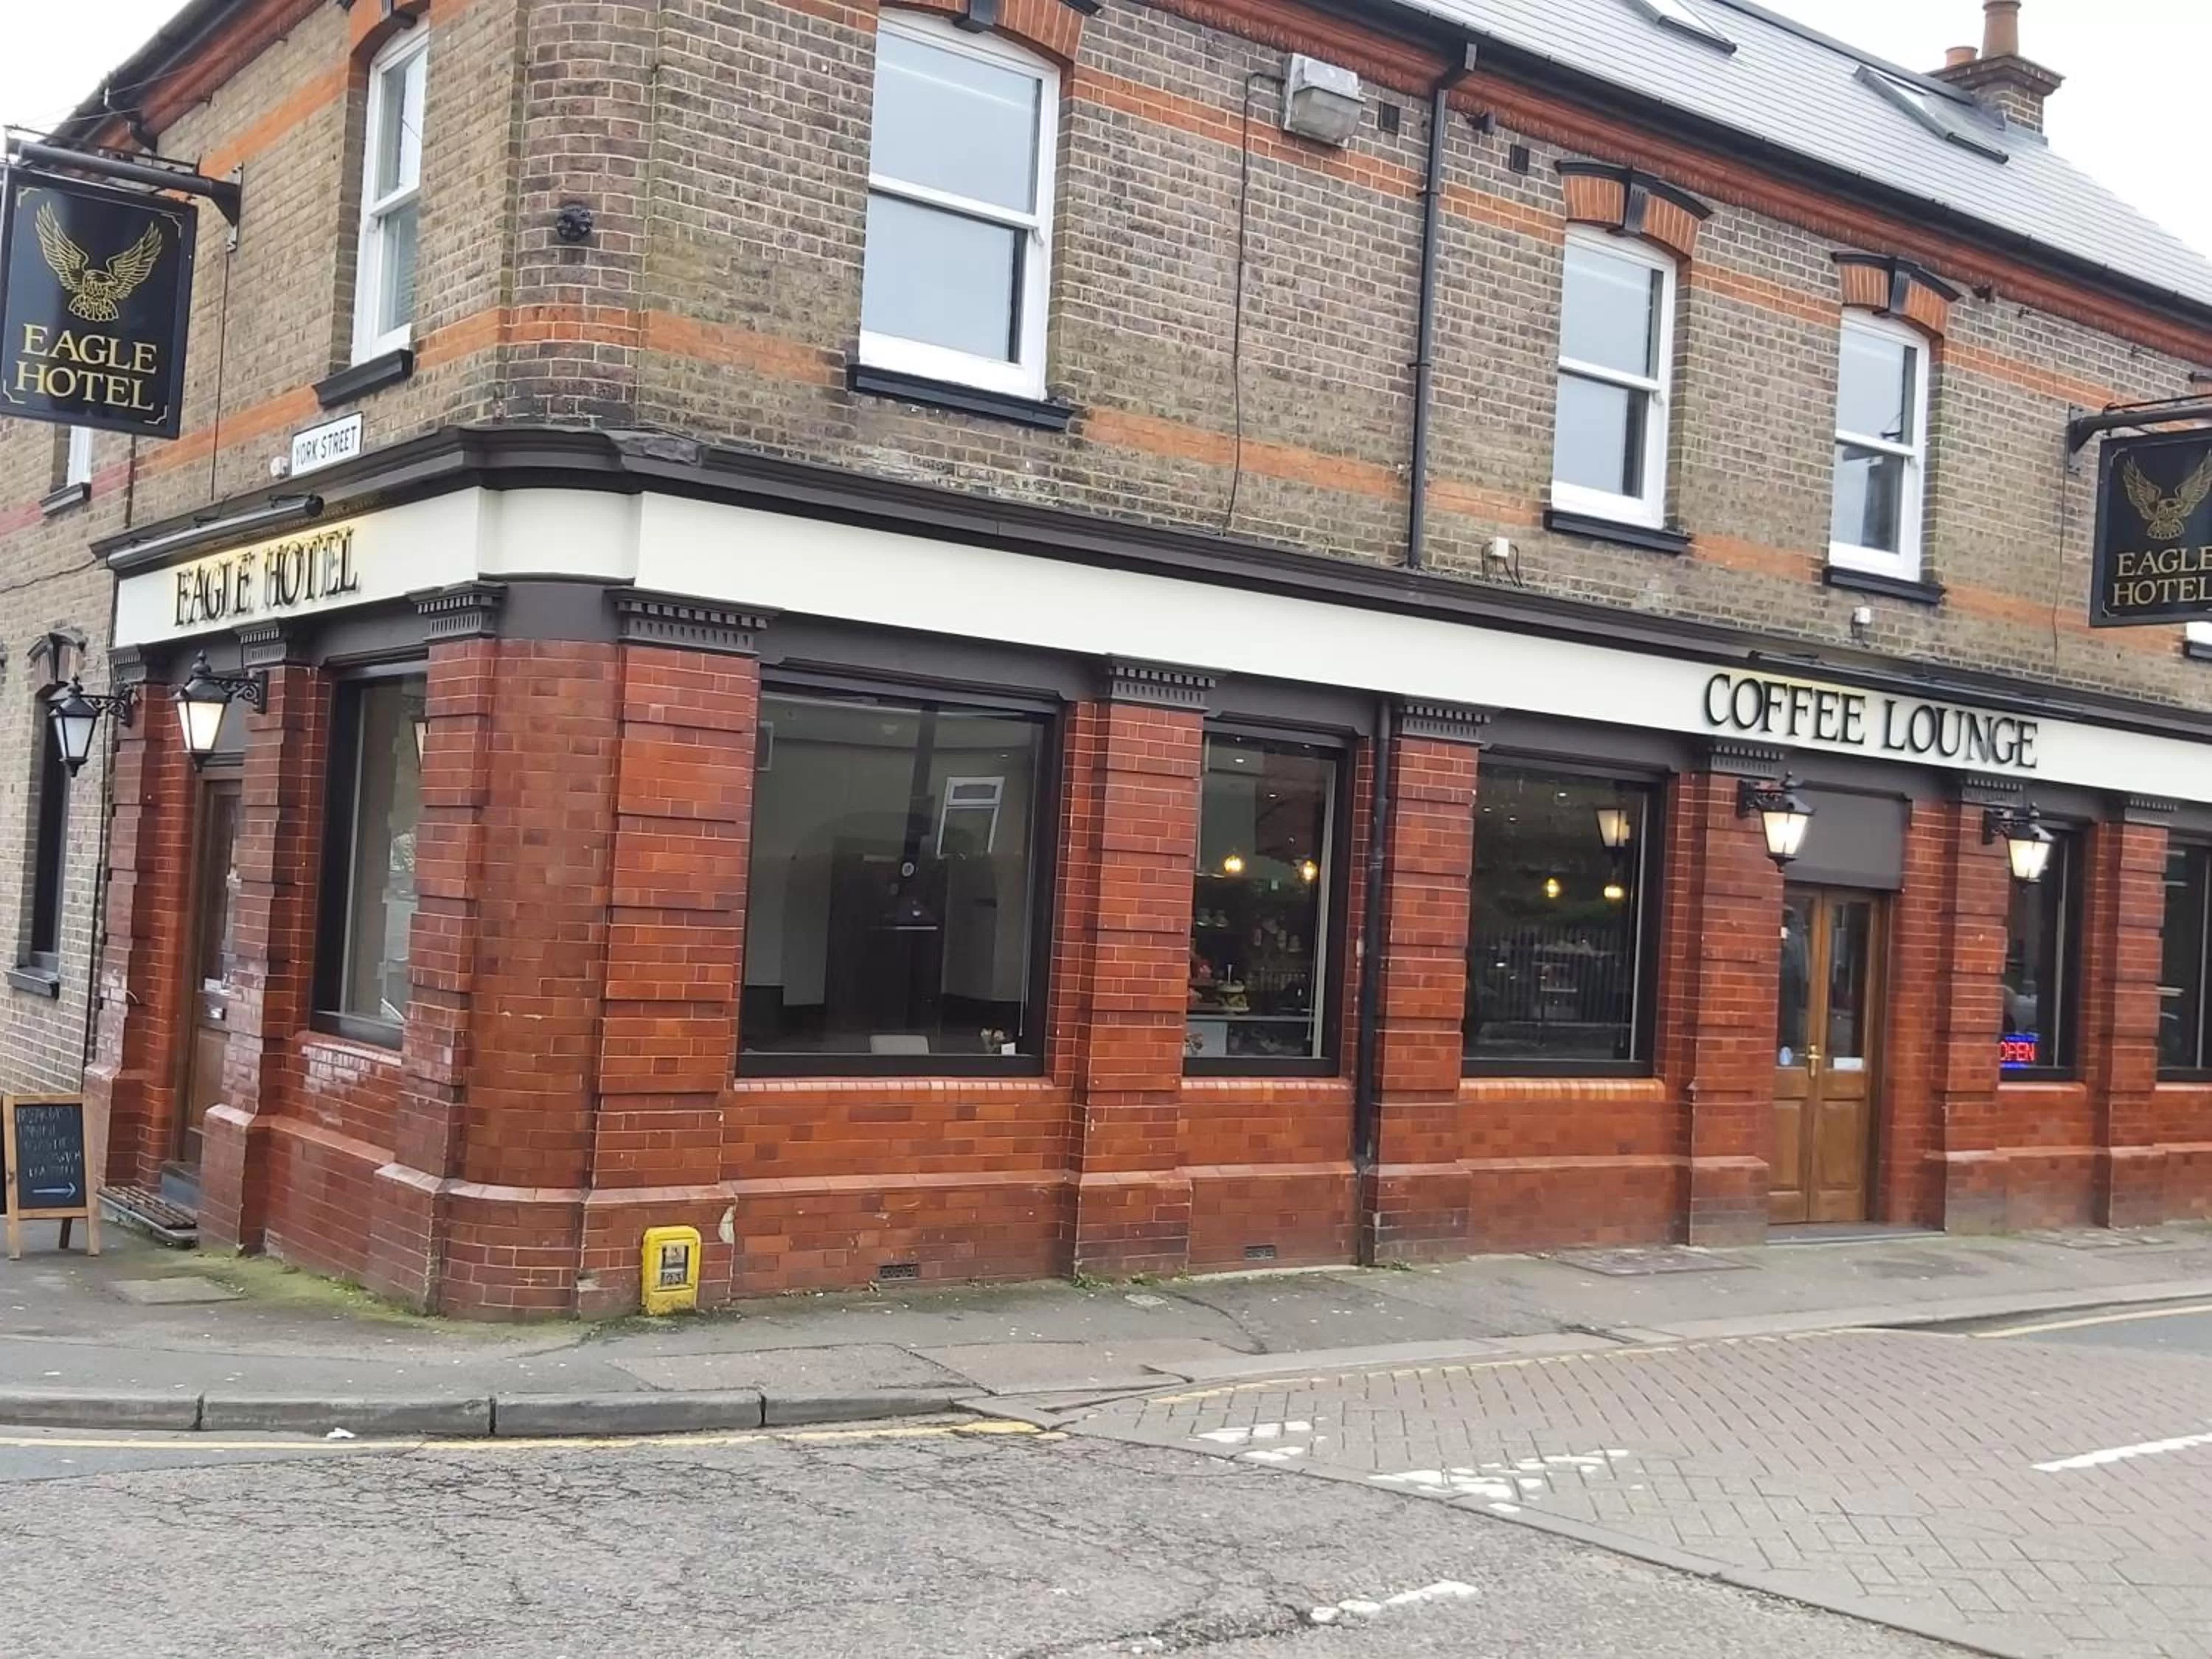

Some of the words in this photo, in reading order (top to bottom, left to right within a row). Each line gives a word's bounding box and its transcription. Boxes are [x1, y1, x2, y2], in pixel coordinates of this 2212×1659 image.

[23, 324, 157, 375] EAGLE
[15, 361, 154, 411] HOTEL
[296, 438, 319, 467] YORK
[321, 425, 357, 459] STREET
[175, 552, 255, 626] EAGLE
[263, 526, 358, 609] HOTEL
[2117, 546, 2212, 577] EAGLE
[2112, 575, 2212, 606] HOTEL
[1704, 672, 1866, 745] COFFEE
[1882, 699, 2039, 769] LOUNGE
[2000, 1042, 2035, 1062] OPEN
